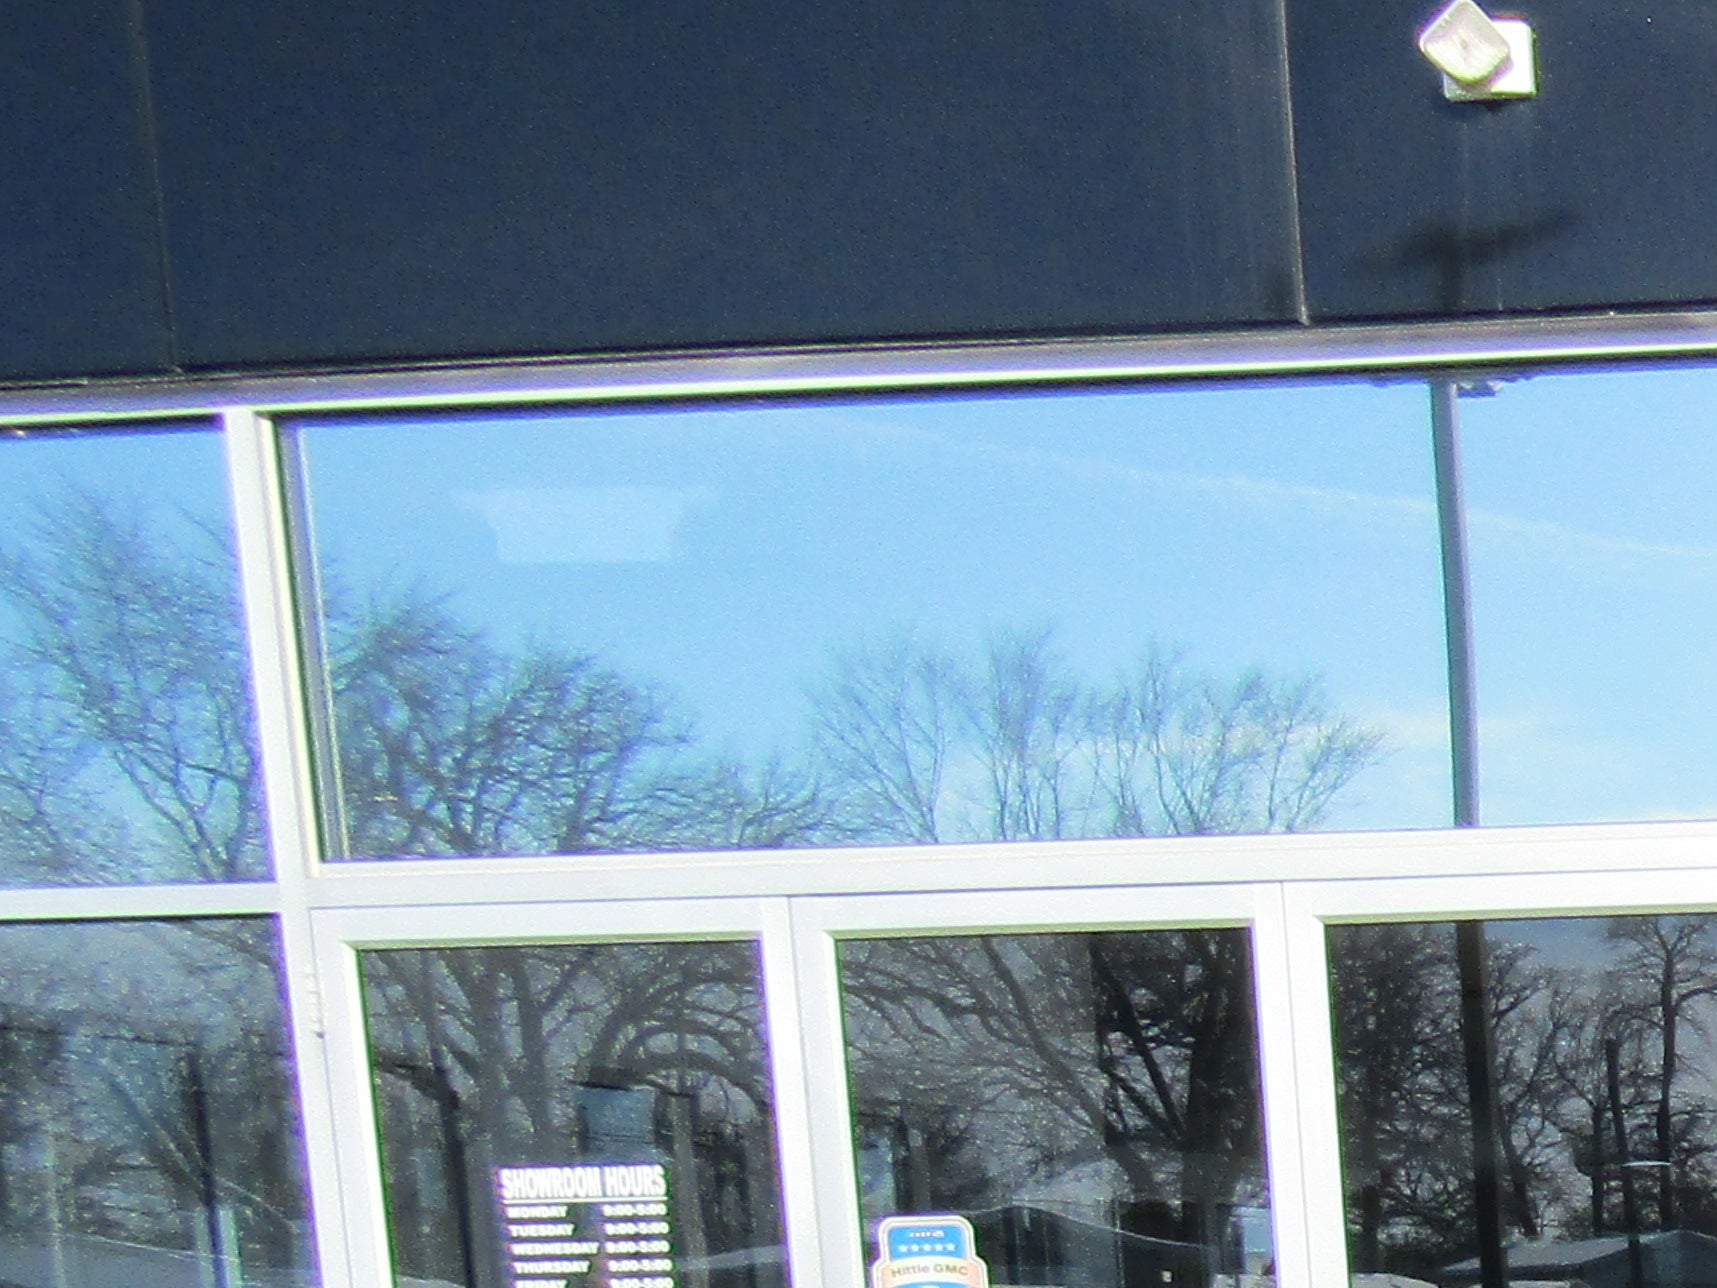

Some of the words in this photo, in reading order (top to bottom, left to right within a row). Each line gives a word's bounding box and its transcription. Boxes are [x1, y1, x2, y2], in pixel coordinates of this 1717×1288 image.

[501, 1166, 602, 1199] SHOWROOM
[604, 1164, 666, 1197] HOURS
[506, 1205, 567, 1218] MONDAY
[508, 1224, 574, 1237] TUESDAY
[511, 1242, 599, 1255] WEDNESDAY
[513, 1261, 590, 1274] THURSDAY
[891, 1263, 931, 1278] Hittle
[932, 1262, 969, 1276] GMC
